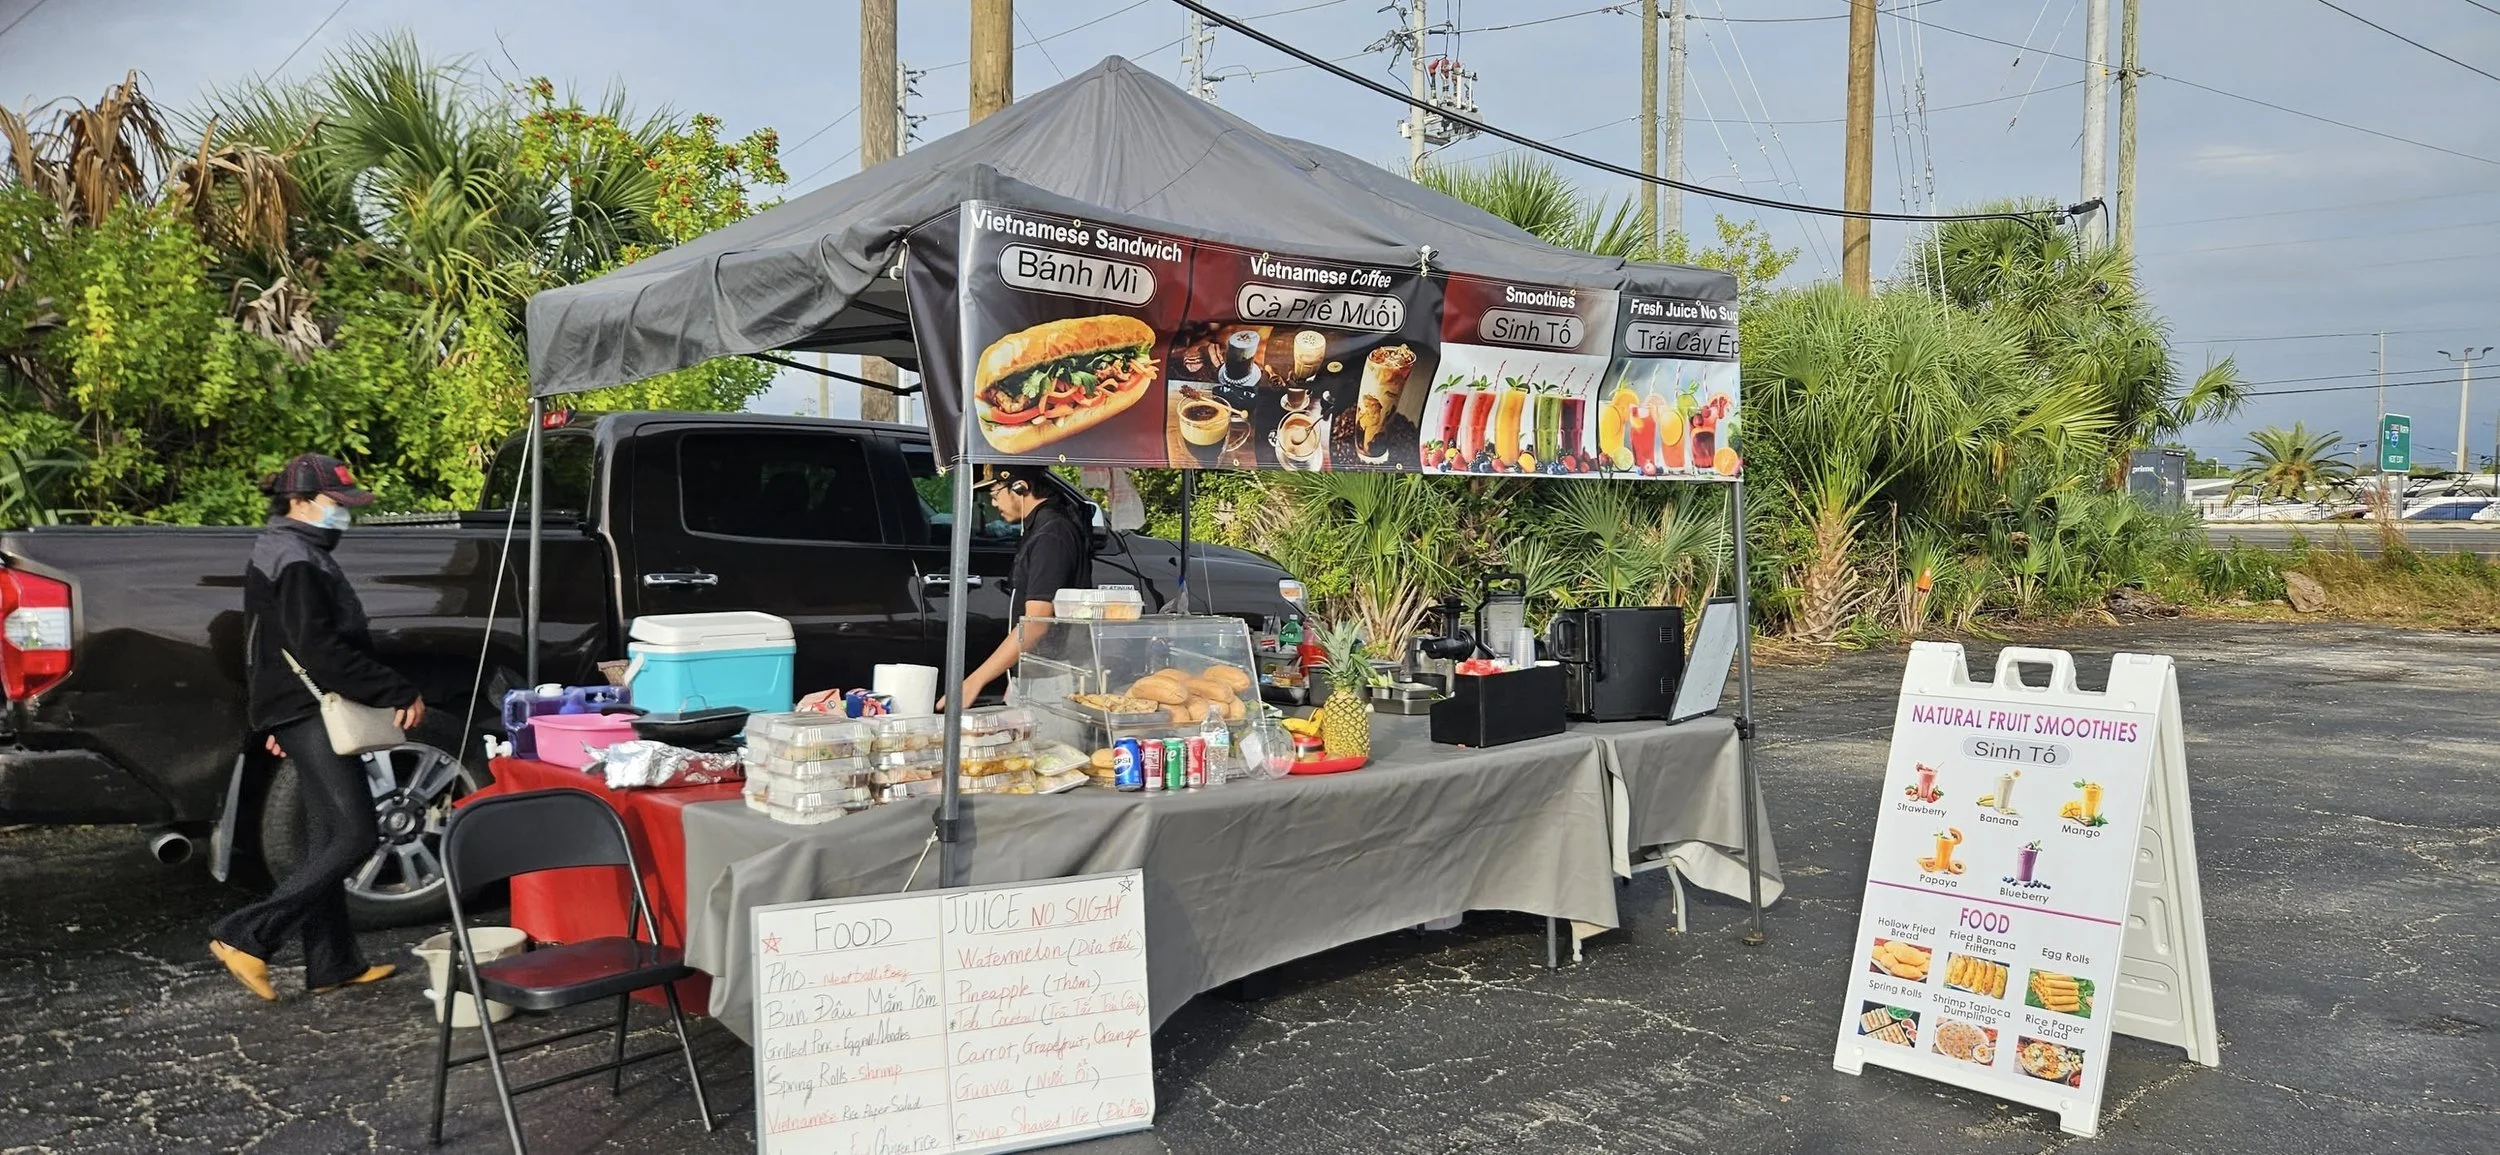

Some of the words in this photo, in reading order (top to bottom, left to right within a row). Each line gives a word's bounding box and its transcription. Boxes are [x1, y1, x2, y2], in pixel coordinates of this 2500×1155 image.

[970, 208, 1090, 247] Vietnamese
[1095, 229, 1184, 263] Sandwich
[1017, 250, 1093, 287] Bánh
[1103, 264, 1139, 295] Mì
[1250, 256, 1347, 286] Vietnamese
[1350, 268, 1392, 289] Coffee
[1505, 285, 1576, 309] Smoothies
[1246, 292, 1281, 319] Cà
[1287, 297, 1333, 322] Phê
[1340, 298, 1398, 329] Muối
[1630, 299, 1664, 317] Fresh
[1665, 300, 1698, 319] Juice
[1700, 304, 1718, 320] No
[1492, 317, 1540, 342] Sinh
[1547, 319, 1572, 345] Tố
[1637, 328, 1672, 351] Trái
[1676, 331, 1714, 357] Cây
[2131, 465, 2155, 474] prime
[1911, 703, 1983, 730] NATURAL
[1988, 710, 2031, 733] FRUIT
[2034, 714, 2139, 745] SMOOTHIES
[1113, 757, 1132, 766] EPSI
[1973, 740, 2021, 761] Sinh
[2030, 744, 2057, 765] Tố
[1896, 801, 1947, 818] Strawberry
[1979, 812, 2020, 828] Banana
[2061, 823, 2102, 840] Mango
[1919, 873, 1958, 889] Papaya
[1999, 886, 2050, 905] Blueberry
[1031, 901, 1055, 927] NO
[1878, 916, 1910, 931] Hollow
[1912, 921, 1937, 936] Fried
[1959, 906, 2011, 935] FOOD
[814, 909, 893, 951] FOOD
[1891, 927, 1920, 942] Bread
[1949, 929, 1975, 944] Fried
[1976, 934, 2017, 951] Banana
[957, 937, 1068, 970] Watermelon
[1964, 940, 1998, 957] Fritters
[2042, 946, 2063, 962] Egg
[2066, 951, 2091, 966] Rolls
[957, 974, 1035, 1009] Pineapple
[1868, 979, 1897, 996] Spring
[1899, 985, 1923, 1000] Rolls
[1932, 993, 1968, 1011] Shrimp
[1969, 999, 2012, 1019] Tapioca
[1943, 1004, 1998, 1026] Dumplings
[1093, 1021, 1148, 1048] Orange
[2025, 1013, 2048, 1029] Rice
[2051, 1018, 2086, 1037] Paper
[2037, 1023, 2069, 1041] Salad
[763, 1037, 808, 1061] Grilled
[766, 1064, 815, 1109] Spring
[955, 1071, 1015, 1101] Guava
